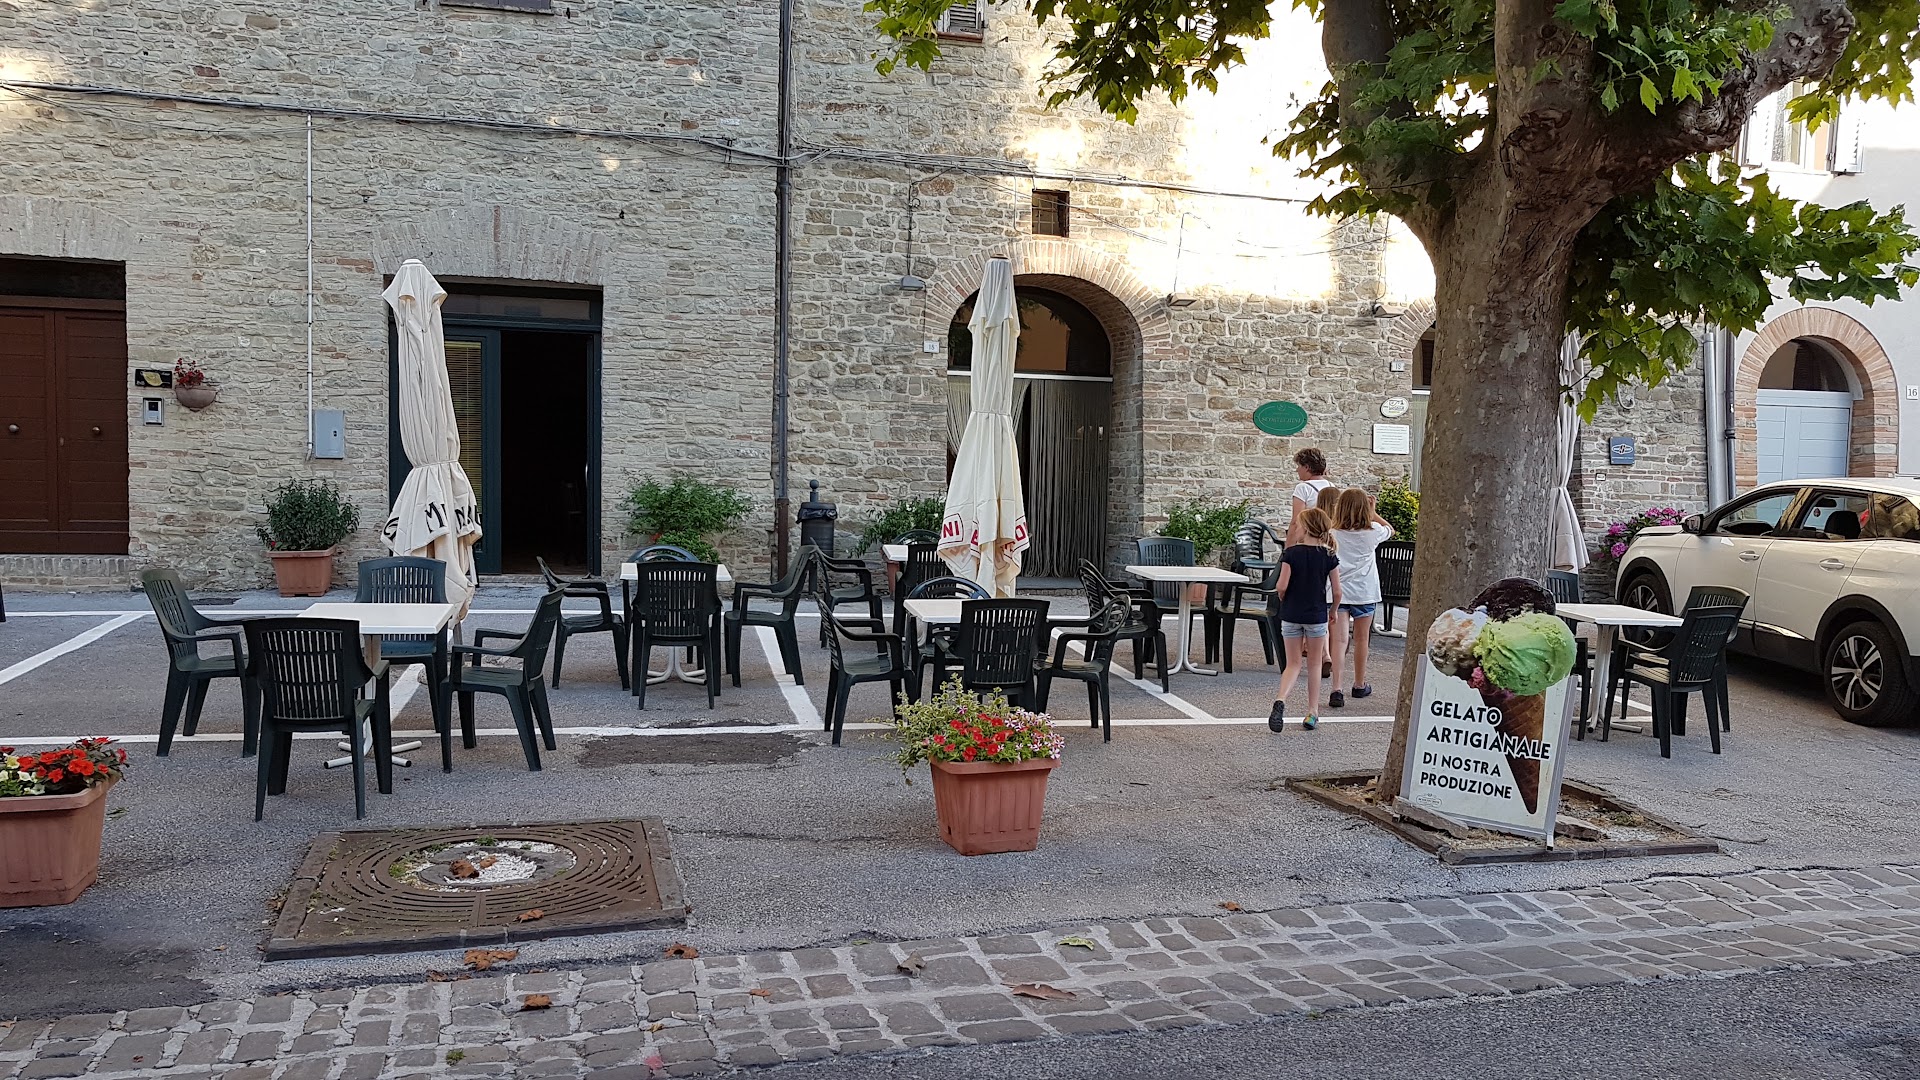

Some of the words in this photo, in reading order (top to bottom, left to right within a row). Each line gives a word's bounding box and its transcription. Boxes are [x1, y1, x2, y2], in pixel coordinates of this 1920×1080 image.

[1908, 388, 1918, 397] 16
[1430, 700, 1501, 725] GELATO
[1426, 725, 1551, 759] ARTIGIANALE
[1422, 751, 1438, 766] DI
[1441, 754, 1501, 777] NOSTRA
[1420, 771, 1512, 799] PRODUZIONE
